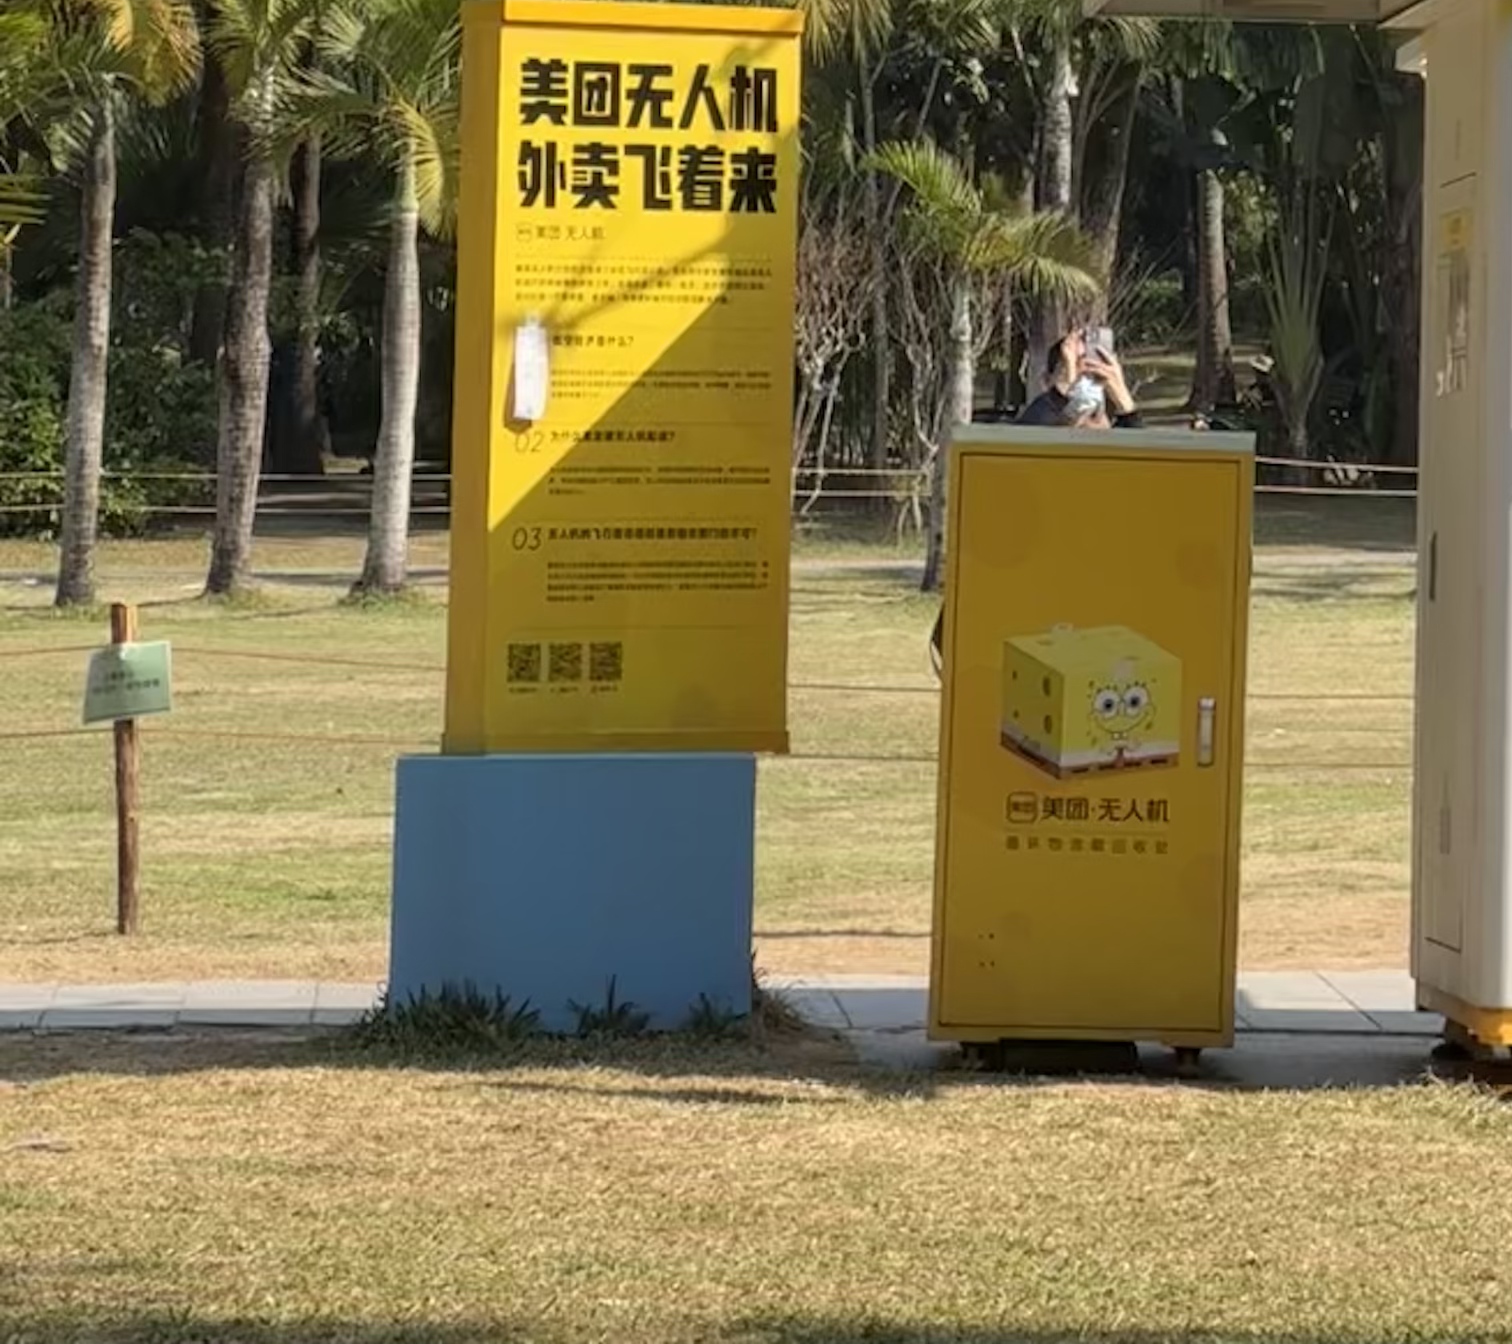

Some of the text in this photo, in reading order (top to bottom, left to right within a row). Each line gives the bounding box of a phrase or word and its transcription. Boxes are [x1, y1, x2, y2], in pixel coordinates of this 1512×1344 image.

[519, 57, 779, 134] 美团无人机
[517, 139, 778, 214] 外卖飞着来
[512, 527, 541, 551] 03
